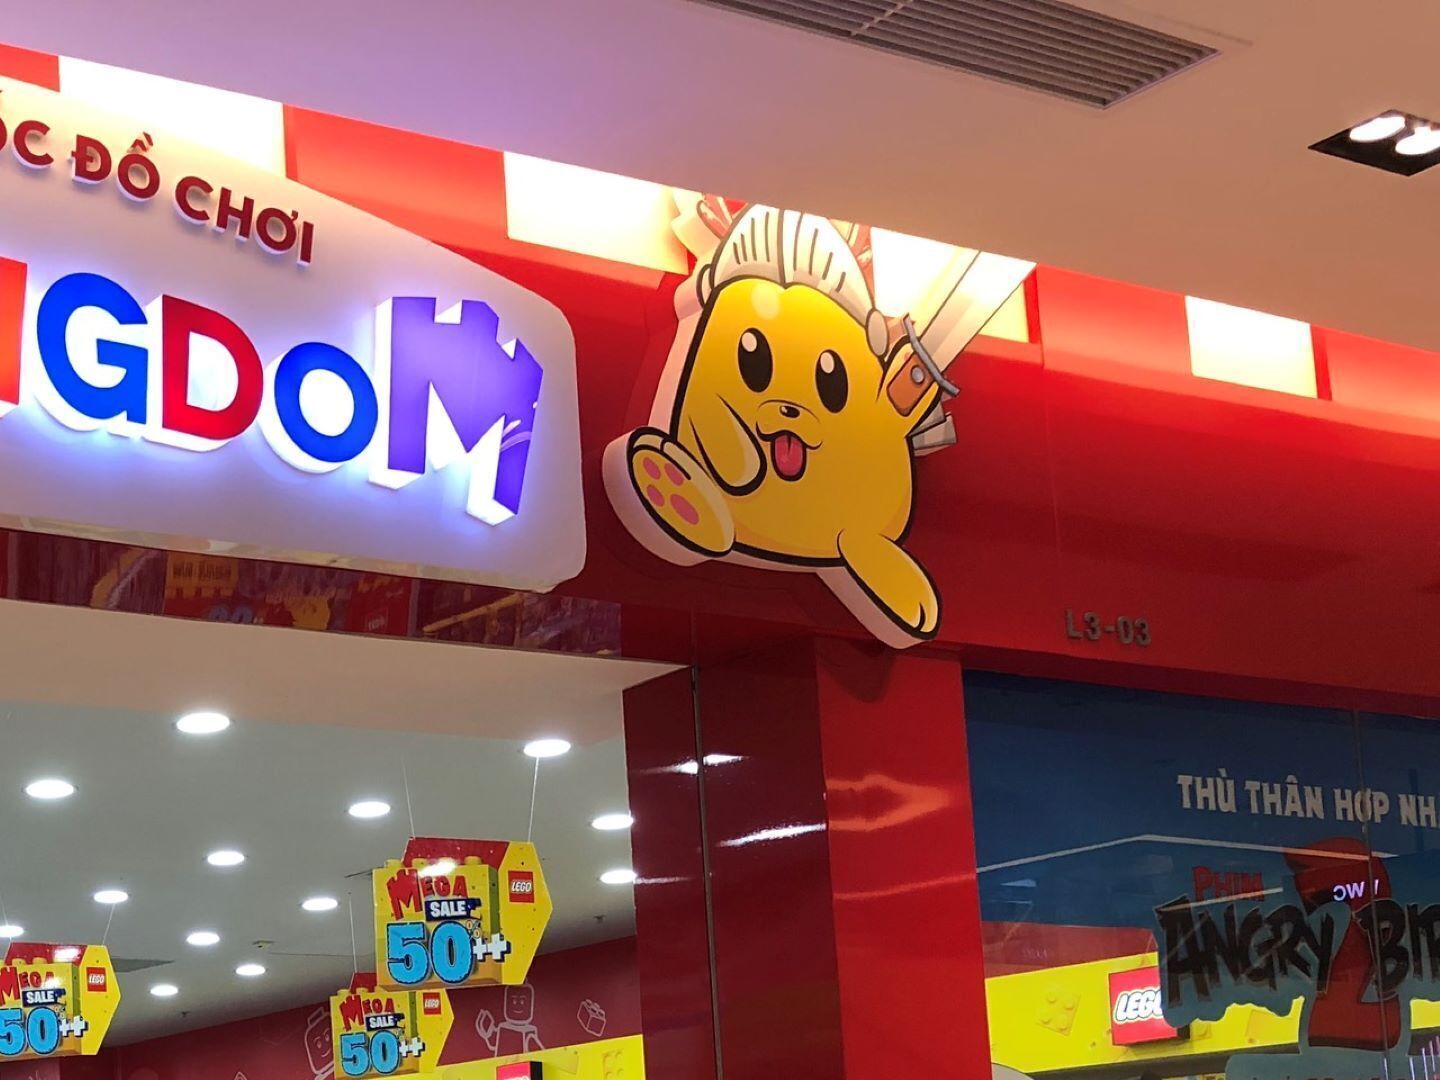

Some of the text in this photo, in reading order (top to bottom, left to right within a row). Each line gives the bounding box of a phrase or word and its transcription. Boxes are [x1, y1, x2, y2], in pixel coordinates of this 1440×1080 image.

[72, 132, 160, 200] ĐỒ
[175, 175, 314, 266] CHƠI
[1065, 609, 1152, 646] L3-03
[1177, 767, 1440, 833] THÙ THÂN HỢP NH
[386, 868, 532, 921] MEGA LEGO
[430, 900, 466, 918] SALE
[1153, 894, 1336, 1008] ANGRY
[26, 990, 55, 1004] SALE
[88, 974, 105, 984] LEGO
[368, 1015, 396, 1029] SALE
